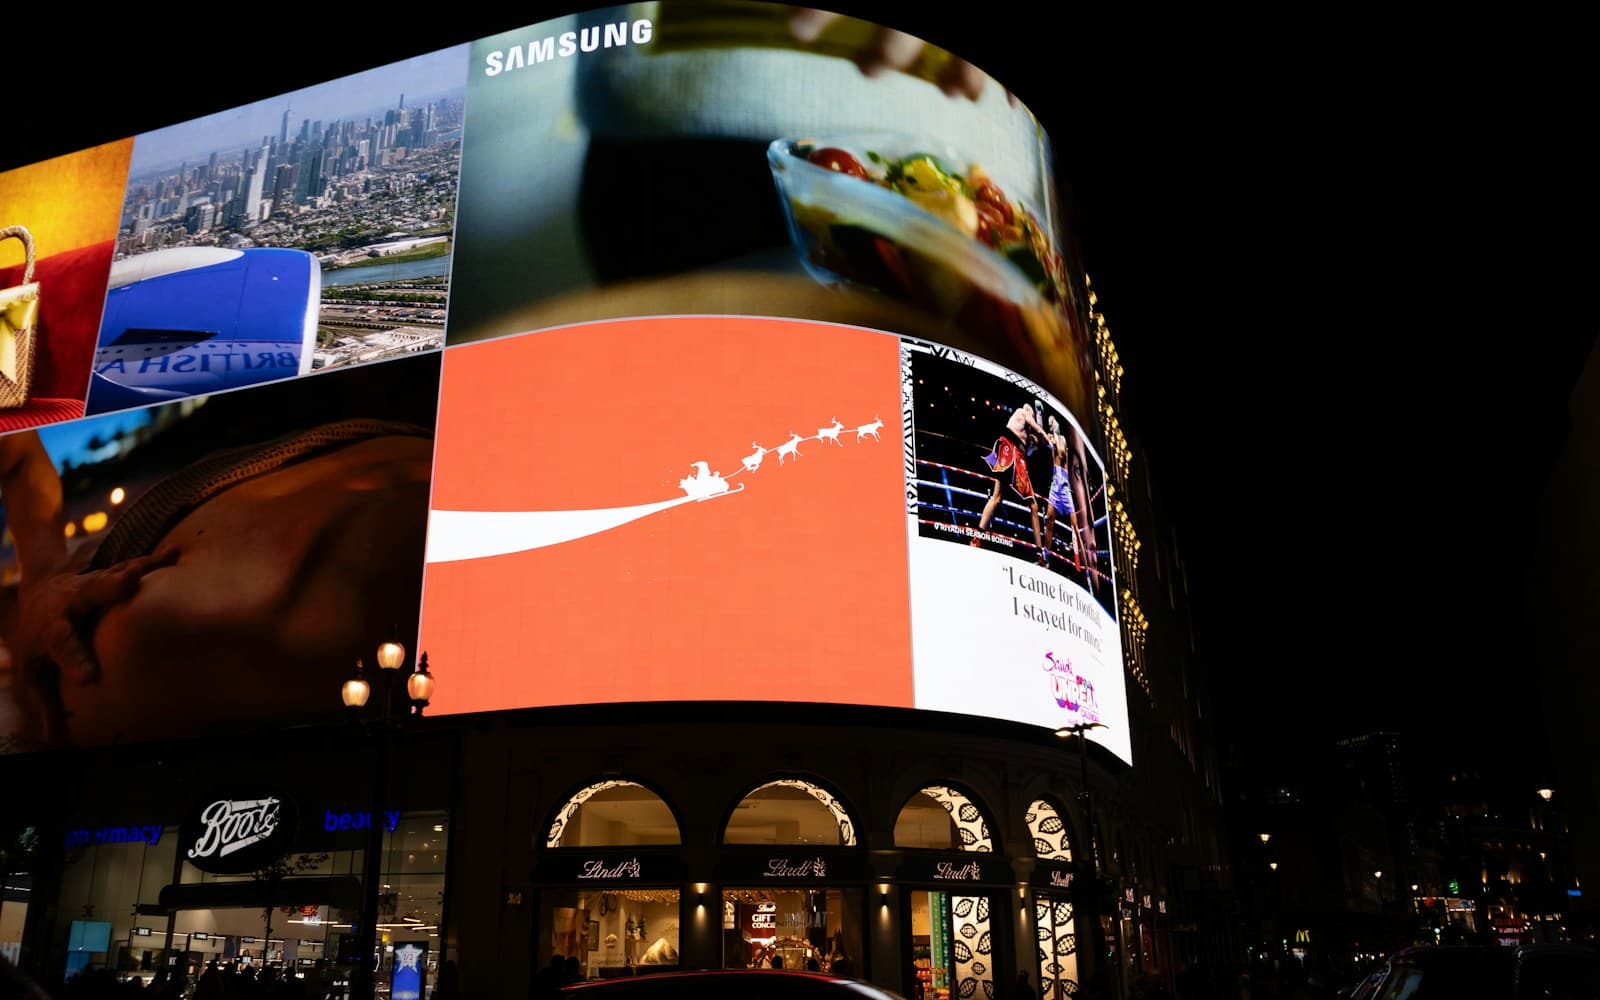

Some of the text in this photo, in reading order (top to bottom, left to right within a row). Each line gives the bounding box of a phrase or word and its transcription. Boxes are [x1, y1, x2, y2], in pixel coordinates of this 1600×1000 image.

[485, 19, 653, 77] SAMSUNG
[965, 528, 990, 541] SEASON
[991, 534, 1014, 547] BOXING
[1019, 574, 1056, 599] came
[1059, 583, 1073, 607] for
[1013, 596, 1018, 615] I
[1023, 603, 1066, 632] stayed
[1068, 615, 1082, 639] for
[187, 797, 280, 859] Boots
[577, 860, 630, 878] Lindt
[763, 858, 812, 877] Lindt
[933, 862, 971, 880] Lindt
[752, 914, 771, 922] GIFT
